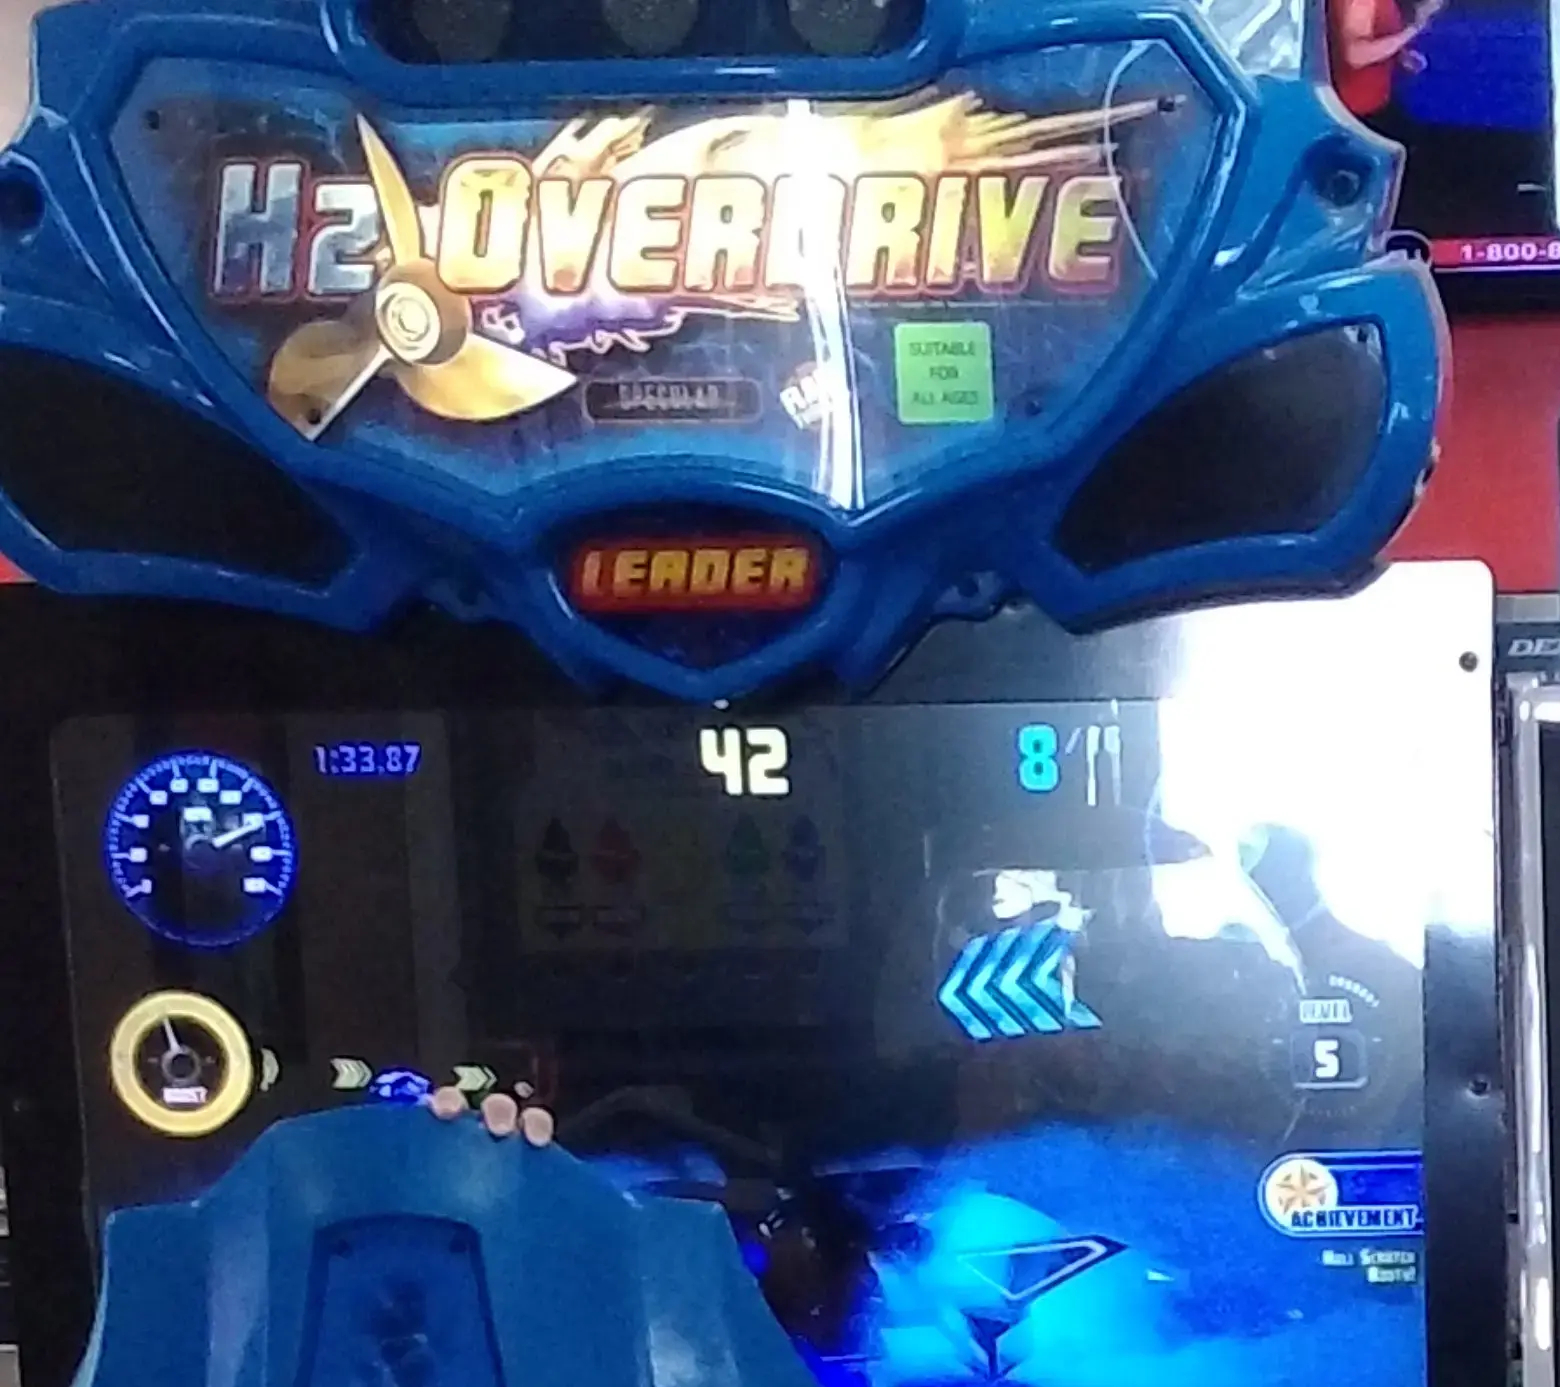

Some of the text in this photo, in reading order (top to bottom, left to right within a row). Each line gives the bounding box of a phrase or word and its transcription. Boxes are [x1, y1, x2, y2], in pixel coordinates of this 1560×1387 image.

[908, 342, 976, 356] SUITABLE
[930, 366, 959, 380] FOR
[911, 390, 978, 405] ALL AGES
[701, 726, 791, 796] 42
[1290, 1207, 1416, 1229] ACHIEVEMENT
